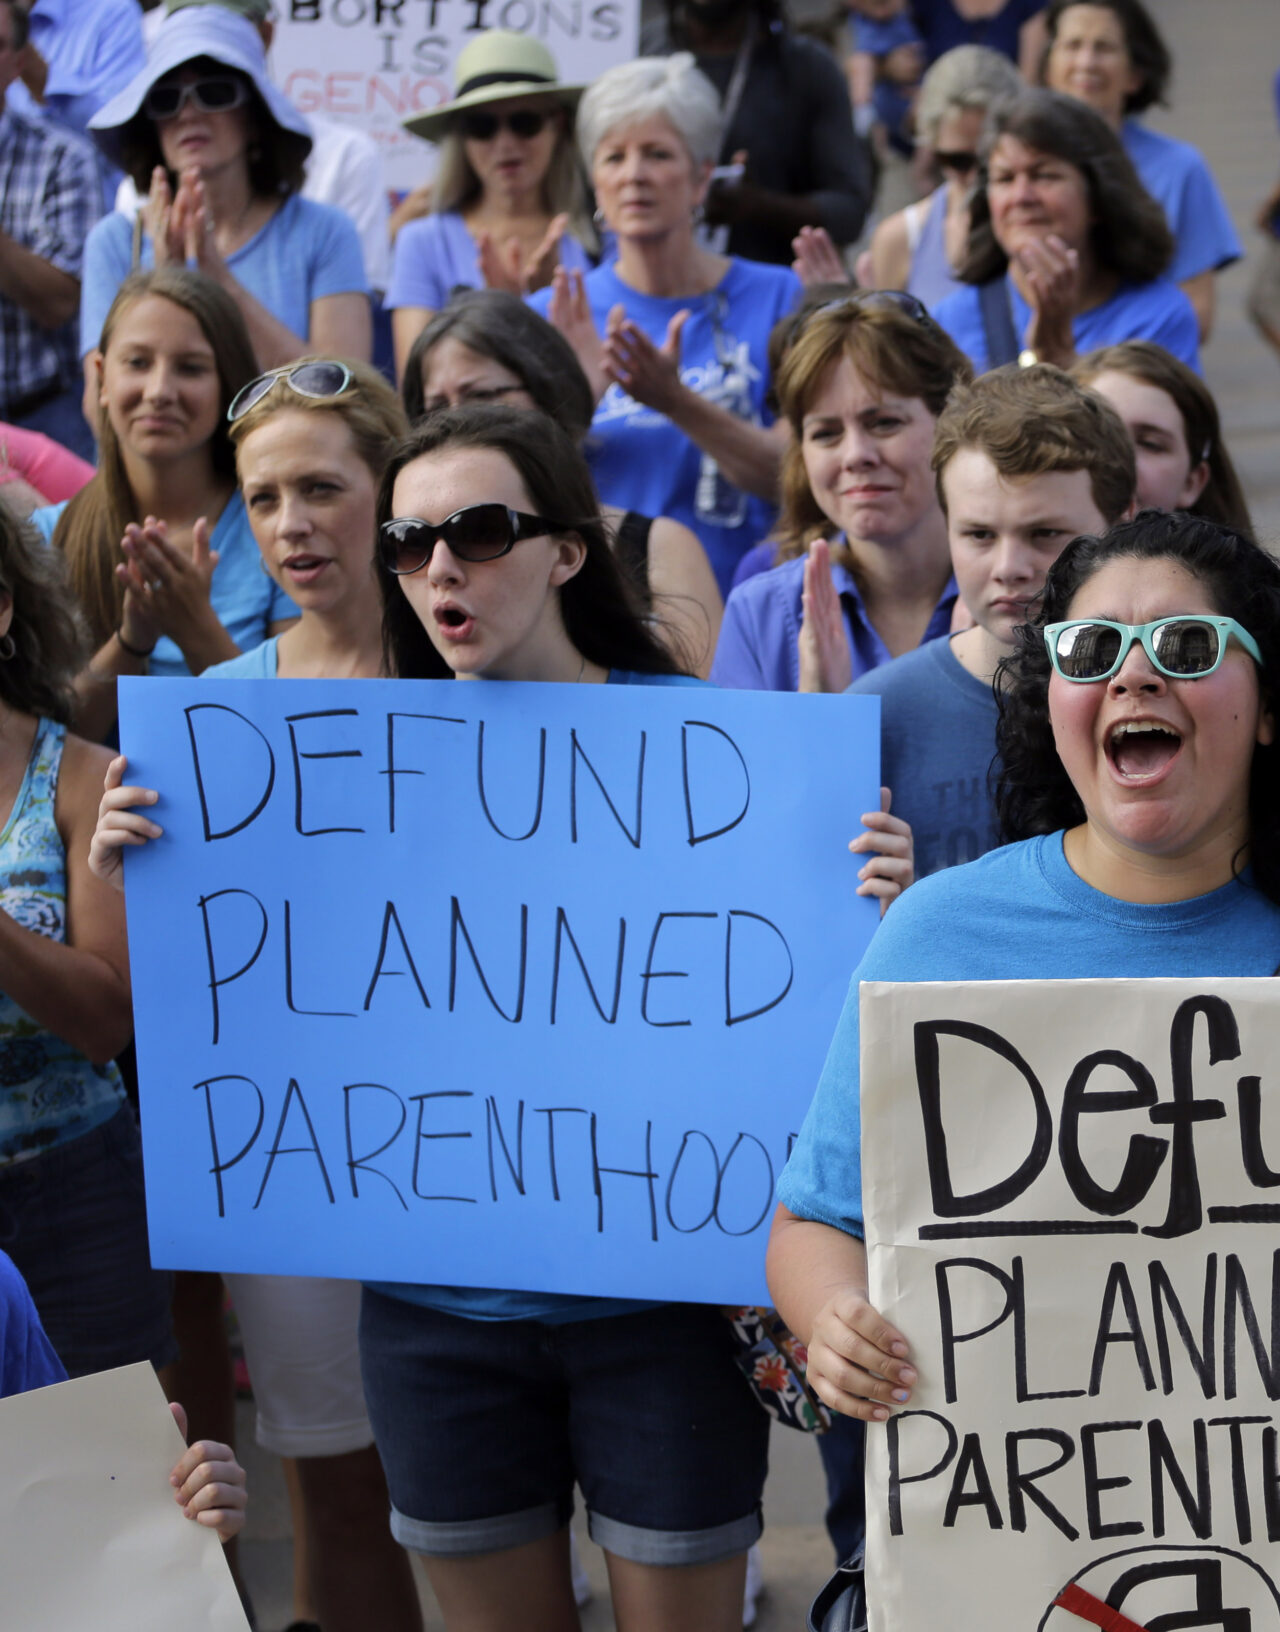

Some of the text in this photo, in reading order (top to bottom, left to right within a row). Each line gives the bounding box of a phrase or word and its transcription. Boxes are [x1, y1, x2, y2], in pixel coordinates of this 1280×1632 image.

[268, 0, 622, 41] BORTIONS
[378, 35, 449, 74] IS
[183, 702, 750, 849] DEFUND
[196, 888, 794, 1046] PLANNED
